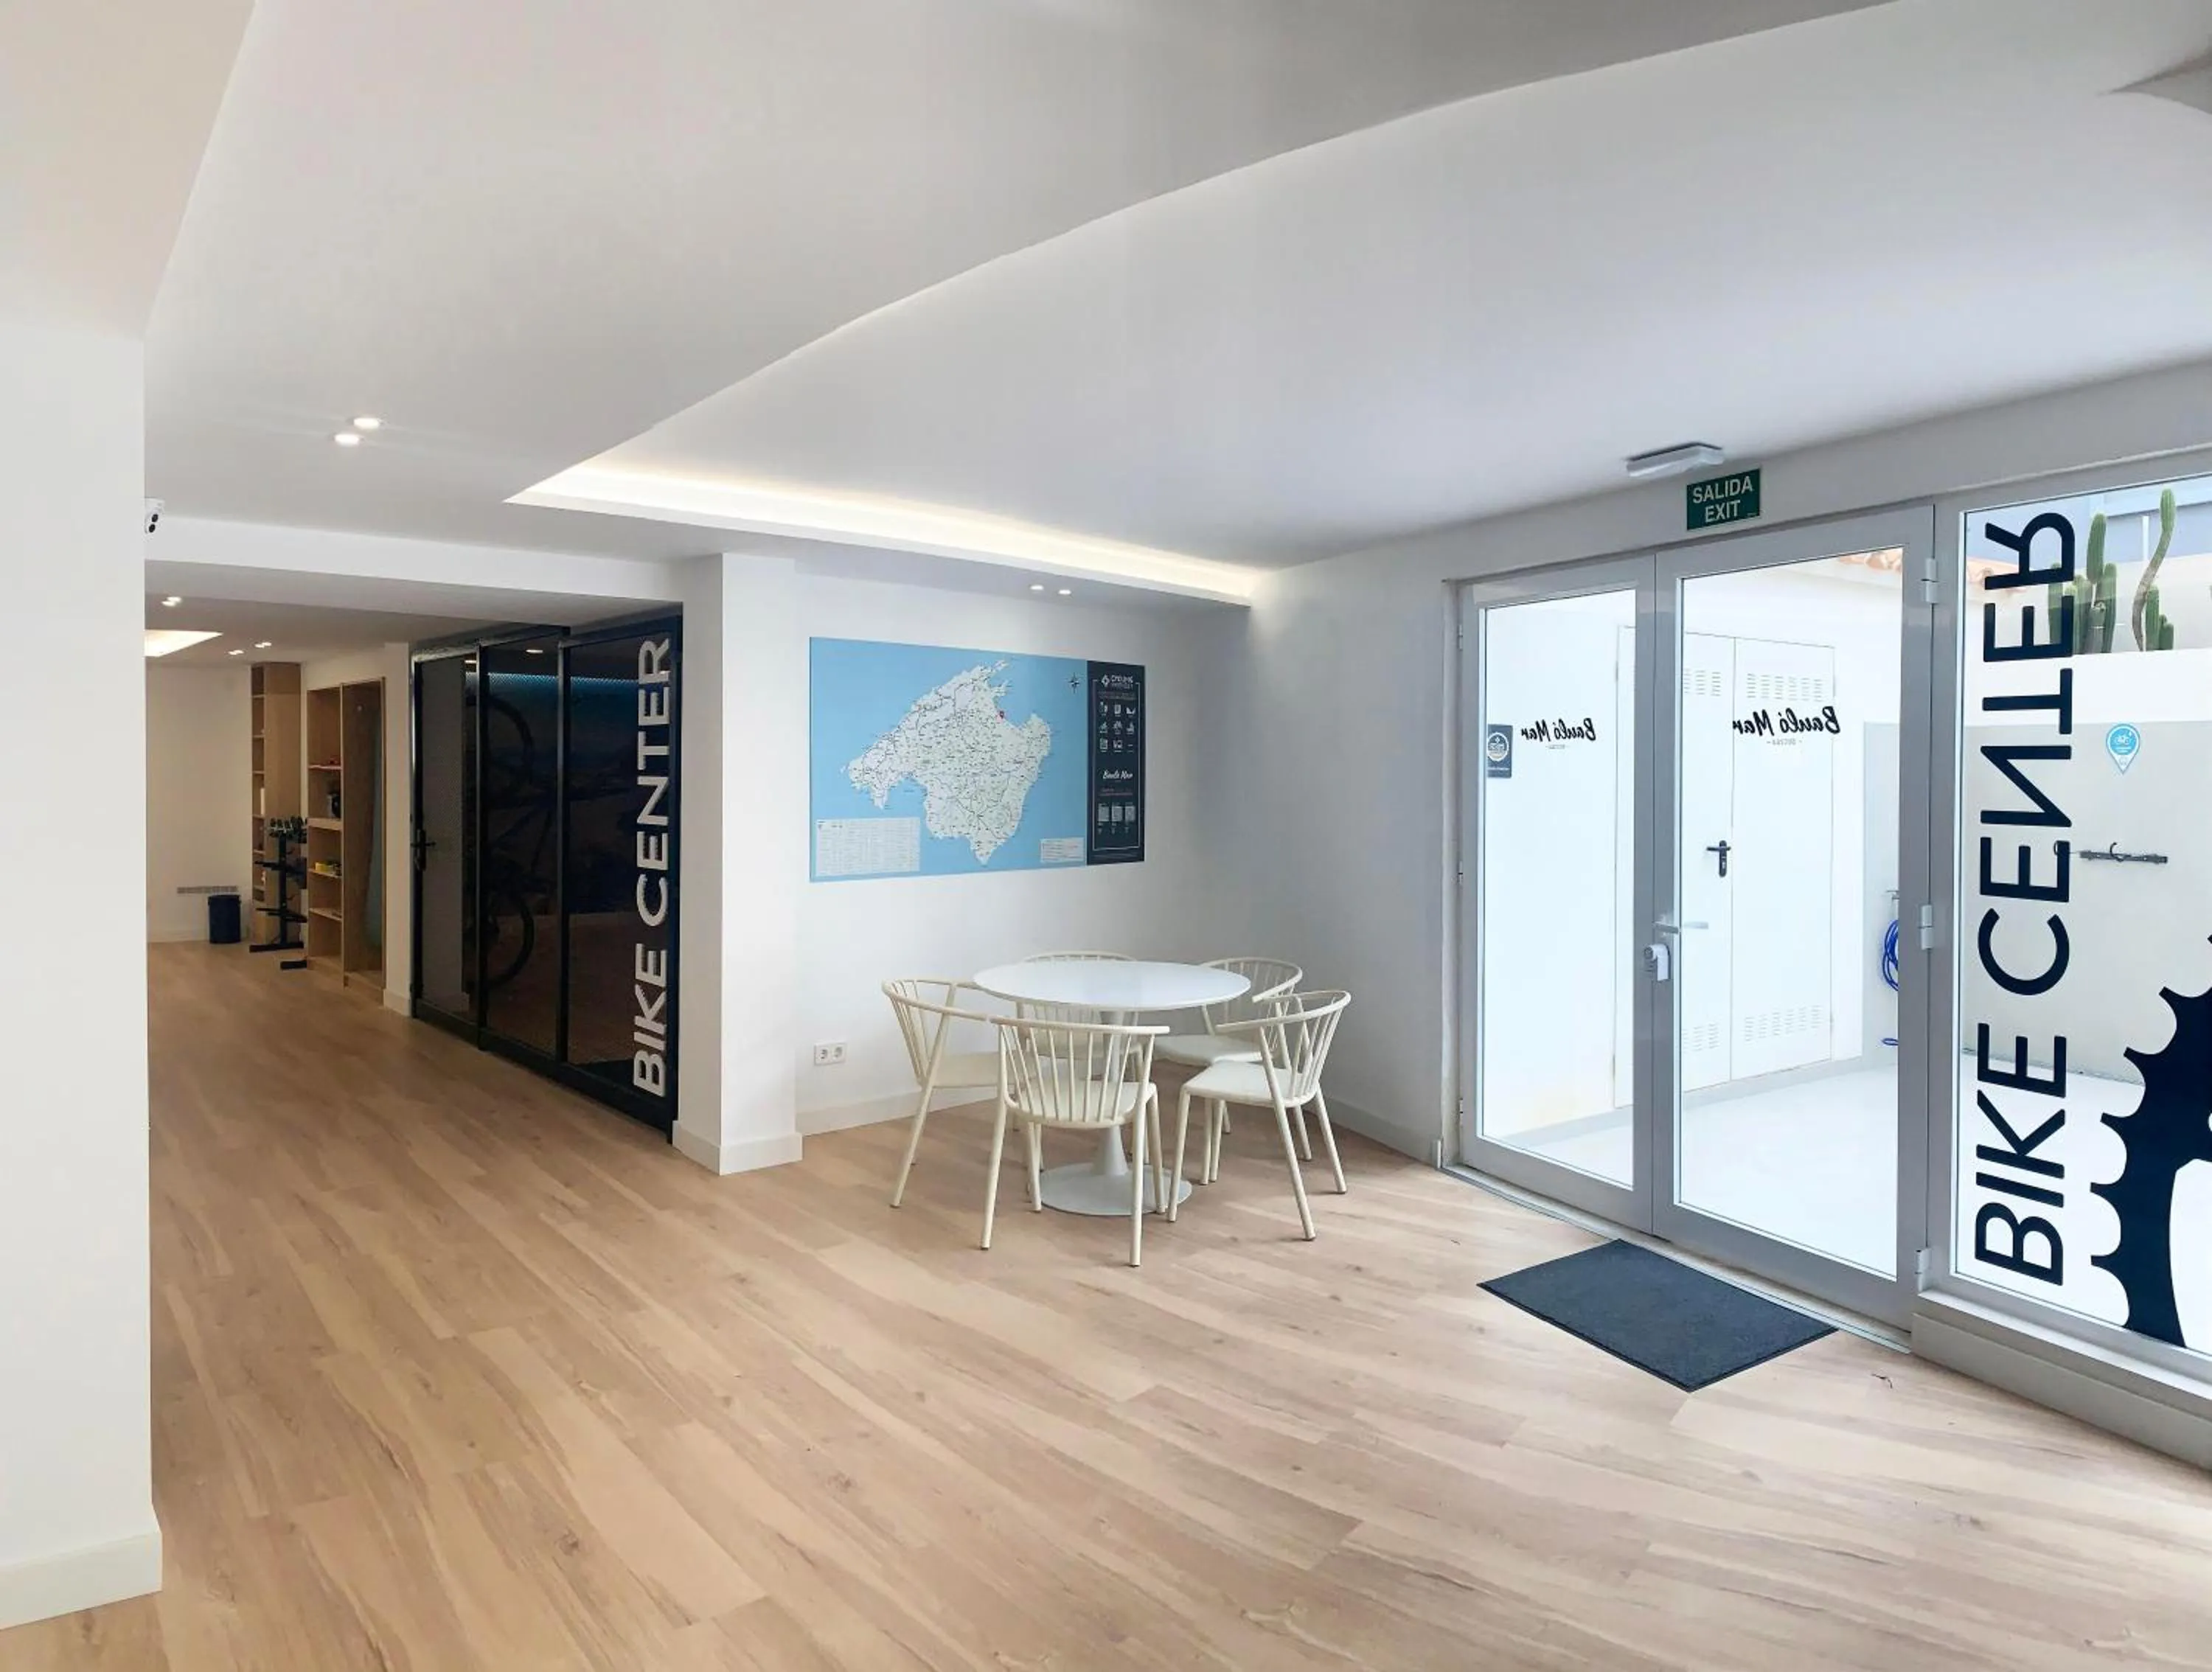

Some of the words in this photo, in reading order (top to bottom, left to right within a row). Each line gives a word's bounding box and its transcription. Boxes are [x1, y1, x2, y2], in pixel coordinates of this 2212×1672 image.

[1692, 476, 1753, 504] SALIDA
[1705, 499, 1742, 523] EXIT
[636, 638, 671, 927] CENTER
[633, 943, 667, 1097] BIKE
